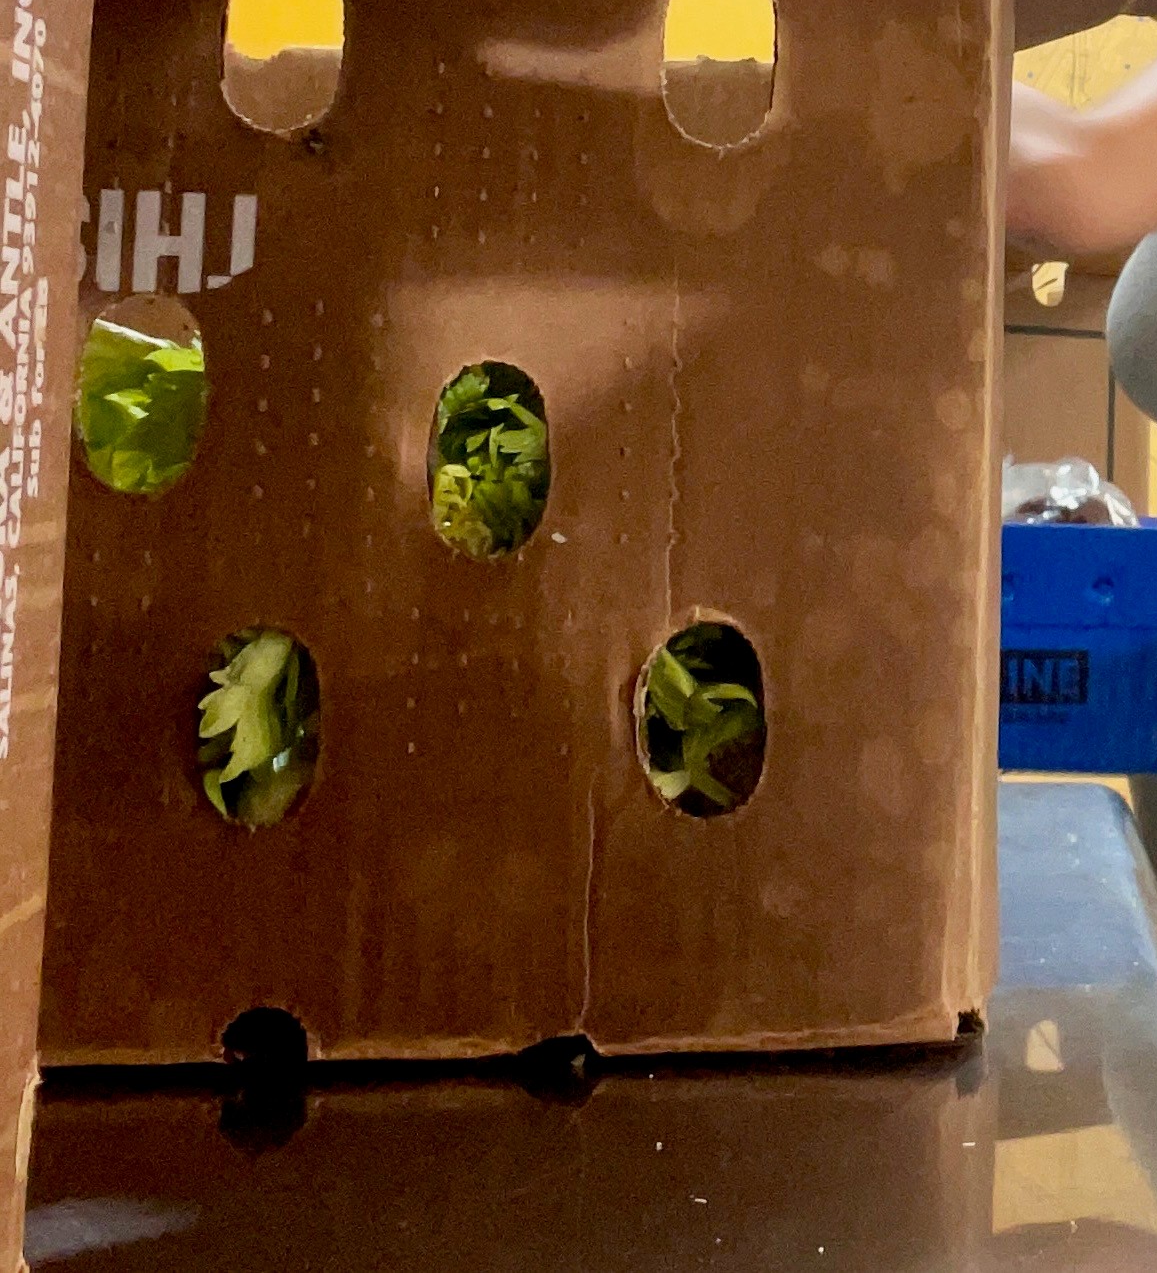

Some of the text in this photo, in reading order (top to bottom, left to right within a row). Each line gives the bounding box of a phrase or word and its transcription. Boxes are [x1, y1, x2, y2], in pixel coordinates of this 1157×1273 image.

[0, 108, 31, 350] ANTLE,
[7, 286, 32, 549] CALIFORNIA
[22, 18, 47, 275] 93912-4070
[28, 418, 42, 499] Sub
